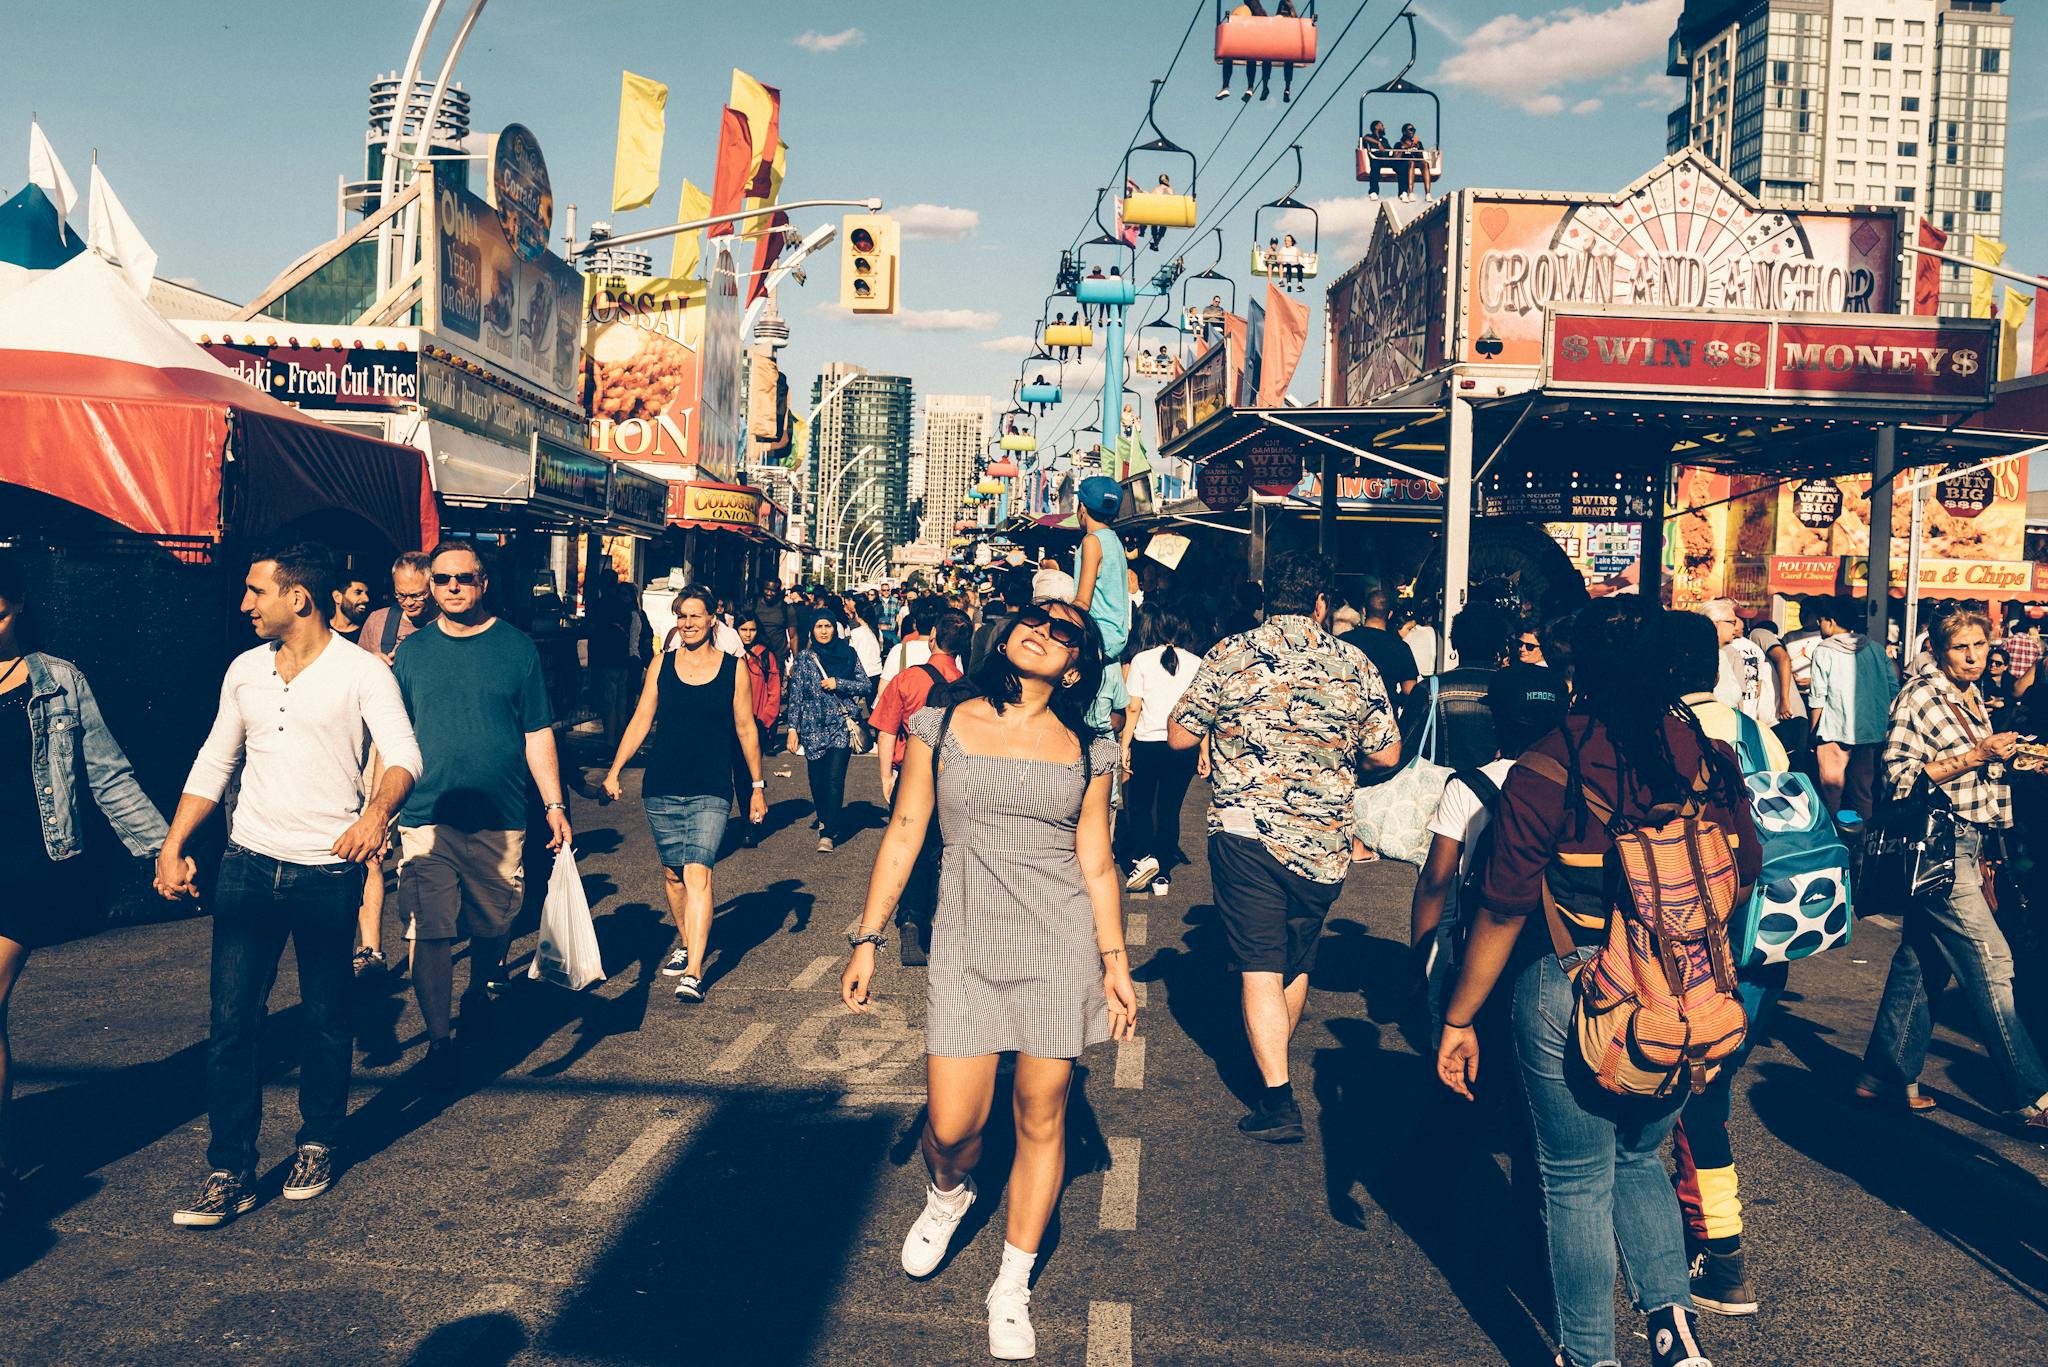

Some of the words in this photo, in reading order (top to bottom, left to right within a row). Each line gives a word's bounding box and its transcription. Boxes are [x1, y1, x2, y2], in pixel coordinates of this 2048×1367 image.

[447, 242, 476, 288] YEERO
[1479, 247, 1617, 317] CROWN
[1628, 251, 1708, 307] AND
[1721, 255, 1875, 313] ANCHOR
[587, 290, 698, 353] OSSAL
[288, 362, 336, 394] Fresh
[341, 365, 369, 396] Cut
[373, 365, 415, 397] Fries
[423, 363, 456, 409] Souvlaki
[461, 380, 488, 423] Burgers
[1248, 454, 1296, 464] WIN
[1253, 466, 1293, 477] BIG
[1204, 475, 1242, 484] WIN
[1944, 475, 1990, 489] WIN
[1206, 486, 1240, 496] BIG
[1944, 488, 1985, 501] BIG
[1798, 492, 1840, 503] WIN
[1571, 506, 1618, 516] MONEY
[1800, 503, 1834, 513] BIG
[712, 509, 752, 521] ONION
[1596, 556, 1611, 565] Lake
[1777, 561, 1836, 572] POUTINE
[1781, 572, 1802, 580] Curd
[1803, 572, 1834, 581] Cheese
[1941, 567, 1960, 583] &
[1964, 564, 2026, 589] Chips
